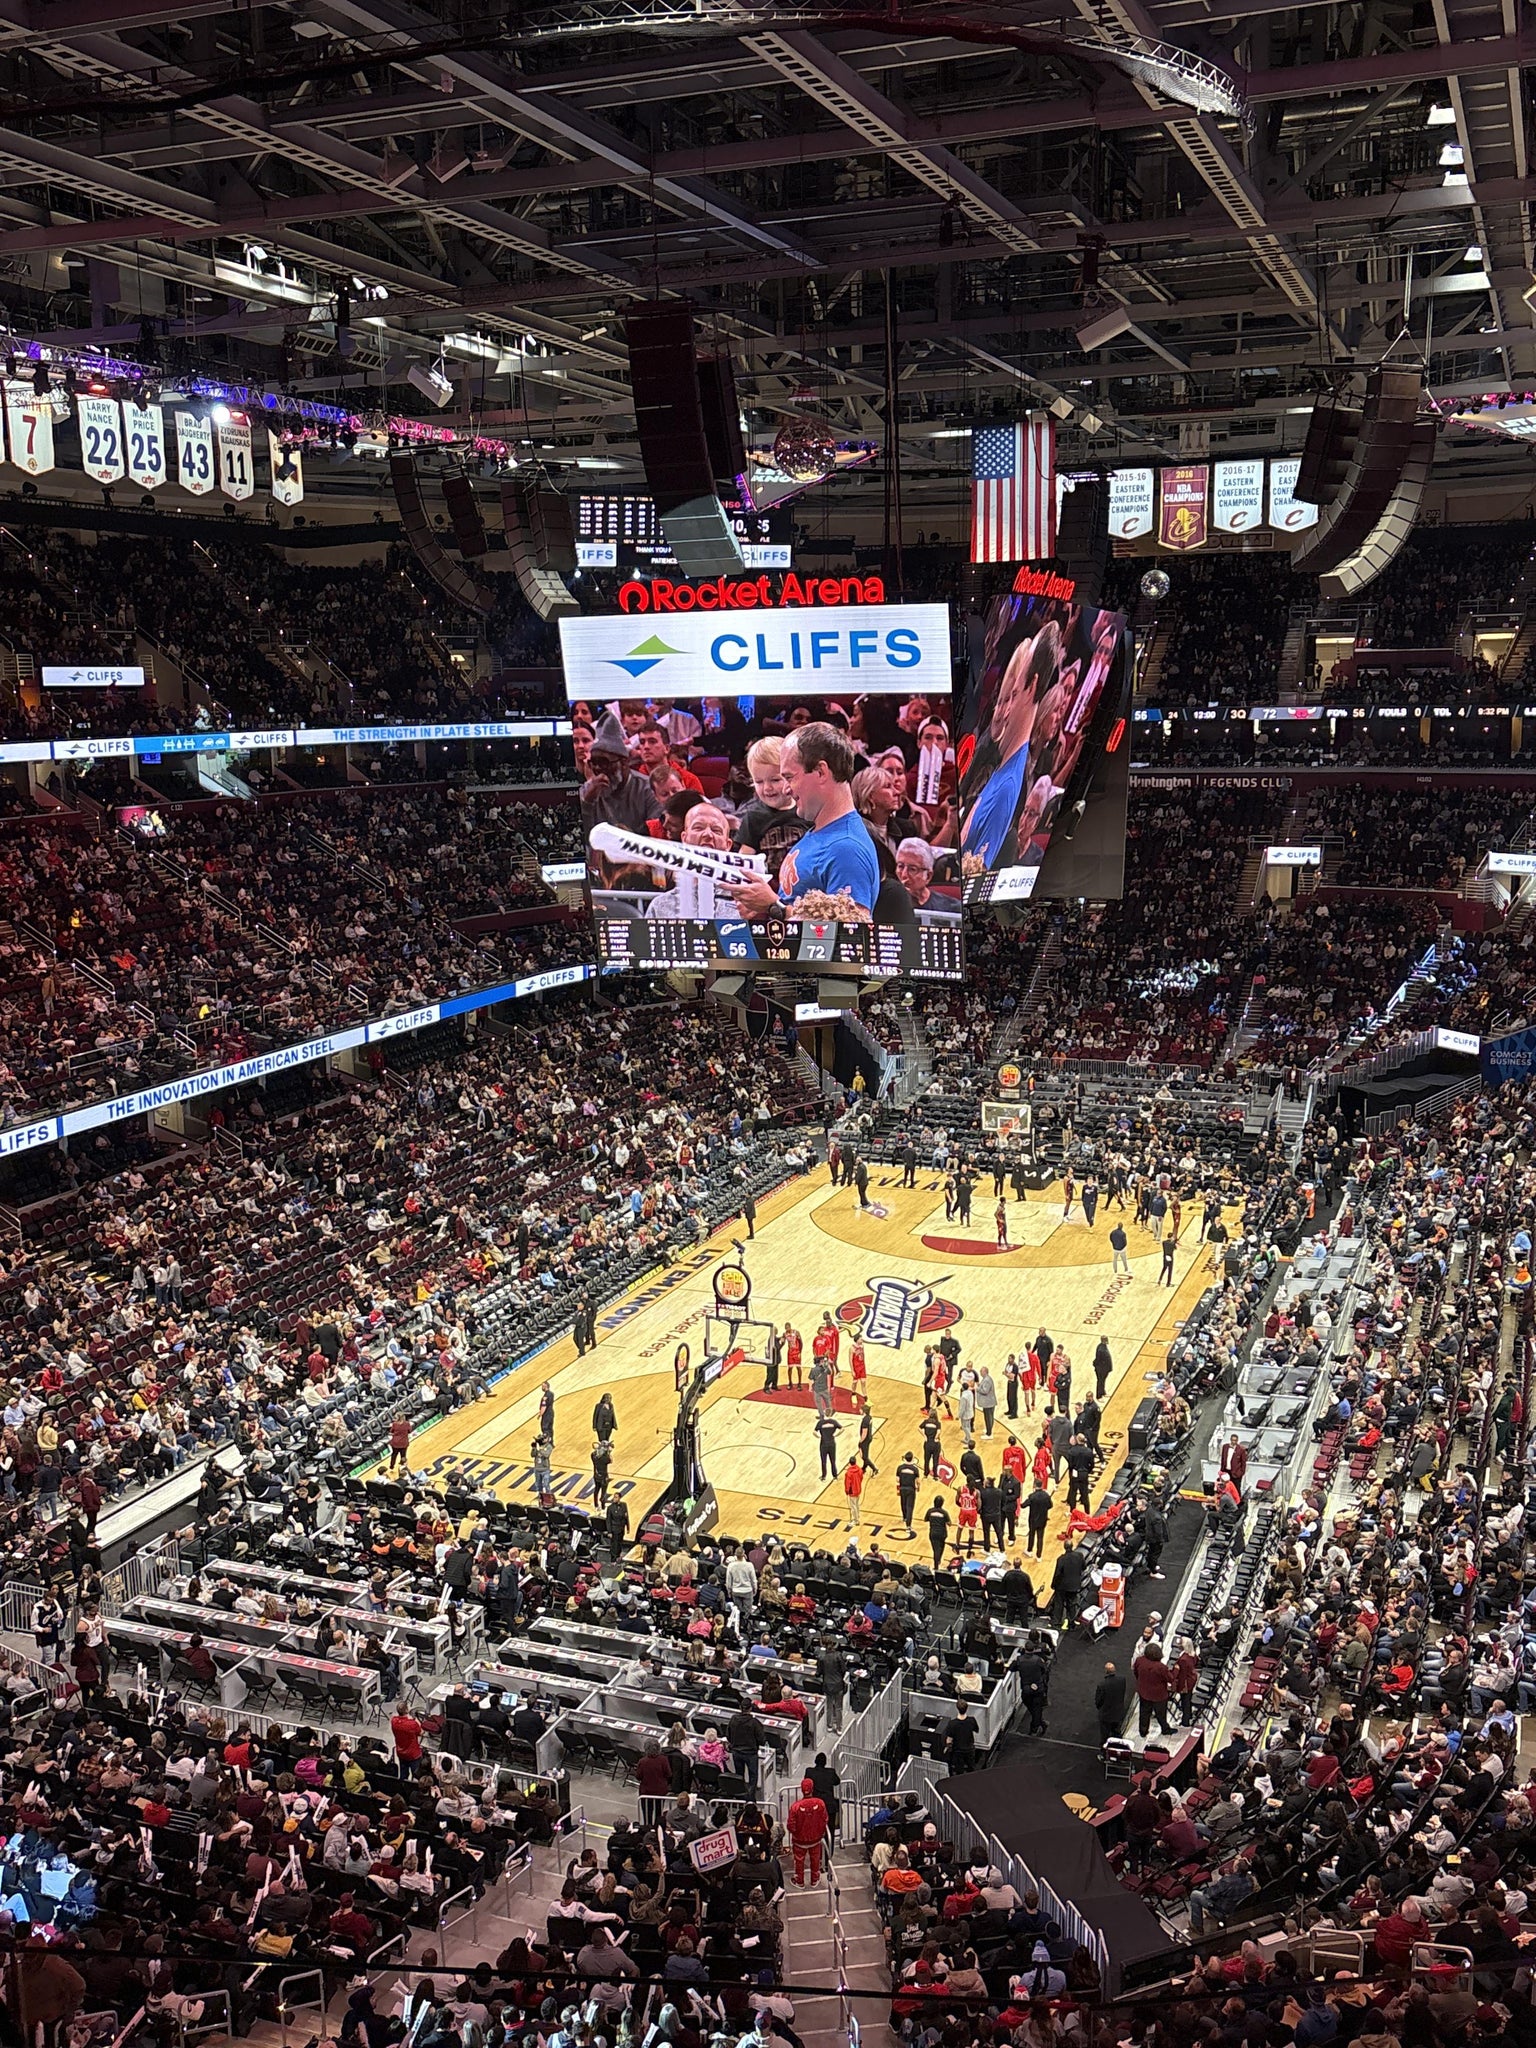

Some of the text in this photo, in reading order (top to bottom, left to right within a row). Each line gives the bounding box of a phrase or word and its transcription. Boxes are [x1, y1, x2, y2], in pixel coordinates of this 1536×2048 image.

[86, 401, 111, 414] LARRY
[87, 412, 113, 425] NANCE
[132, 408, 154, 420] MARK
[133, 419, 155, 431] PRICE
[22, 414, 37, 454] 7
[220, 426, 250, 439] ZYDRUNAS
[86, 425, 119, 467] 22
[131, 432, 162, 472] 25
[182, 441, 209, 479] 43
[226, 450, 248, 485] 11
[1222, 466, 1256, 476] 2016-17
[1114, 472, 1147, 483] 2015-16
[1175, 470, 1194, 479] 2016
[1223, 477, 1254, 486] EASTERN
[1115, 484, 1145, 493] EASTERN
[1176, 484, 1192, 493] NBA
[1217, 487, 1260, 497] CONFERENCE
[1110, 494, 1150, 504] CONFERENCE
[1164, 492, 1204, 503] CHAMPIONS
[1218, 497, 1258, 507] CHAMPIONS
[1111, 504, 1149, 514] CHAMPIONS
[579, 550, 614, 560] IFFS
[742, 551, 788, 561] CLIFFS
[1015, 566, 1076, 600] Rocket Arena
[652, 572, 885, 611] Rocket Arena
[710, 628, 922, 672] CLIFFS
[87, 671, 123, 682] CLIFFS
[1134, 710, 1148, 720] 56
[1168, 711, 1178, 719] 24
[1194, 710, 1216, 719] 12:00
[1230, 709, 1247, 720] 3Q
[1263, 708, 1277, 719] 72
[1352, 708, 1365, 718] 56
[1378, 707, 1422, 717] FOULS 0
[1434, 707, 1465, 717] TOL 4
[1477, 707, 1509, 716] 9:32 PM
[333, 723, 512, 741] THE STRENGTH IN PLATE STEEL
[253, 733, 288, 744] CLIFFS
[88, 741, 131, 754] CLIFFS
[1129, 775, 1191, 791] Huntington
[1203, 777, 1258, 788] LEGENDS
[1286, 851, 1318, 859] CLIFFS
[723, 855, 754, 870] LET
[558, 867, 585, 876] CLIFFS
[686, 862, 715, 878] EM
[1009, 878, 1035, 888] CLIFFS
[752, 924, 765, 934] 3Q
[786, 924, 798, 935] 24
[729, 943, 747, 957] 56
[766, 948, 790, 959] 12:00
[807, 946, 825, 959] 72
[539, 970, 576, 988] CLIFFS
[395, 1010, 433, 1031] CLIFFS
[1453, 1036, 1477, 1048] CLIFFS
[1490, 1051, 1533, 1059] COMCAST
[1490, 1058, 1532, 1066] BUSINESS
[107, 1039, 335, 1119] THE INNOVATION IN AMERICAN STEEL
[0, 1124, 49, 1152] LIFFS
[683, 1249, 724, 1270] LET
[656, 1269, 692, 1288] EM
[1083, 1279, 1131, 1325] Rocket Arena
[638, 1331, 680, 1358] Arena
[698, 1838, 726, 1855] drug
[703, 1848, 734, 1864] mart
